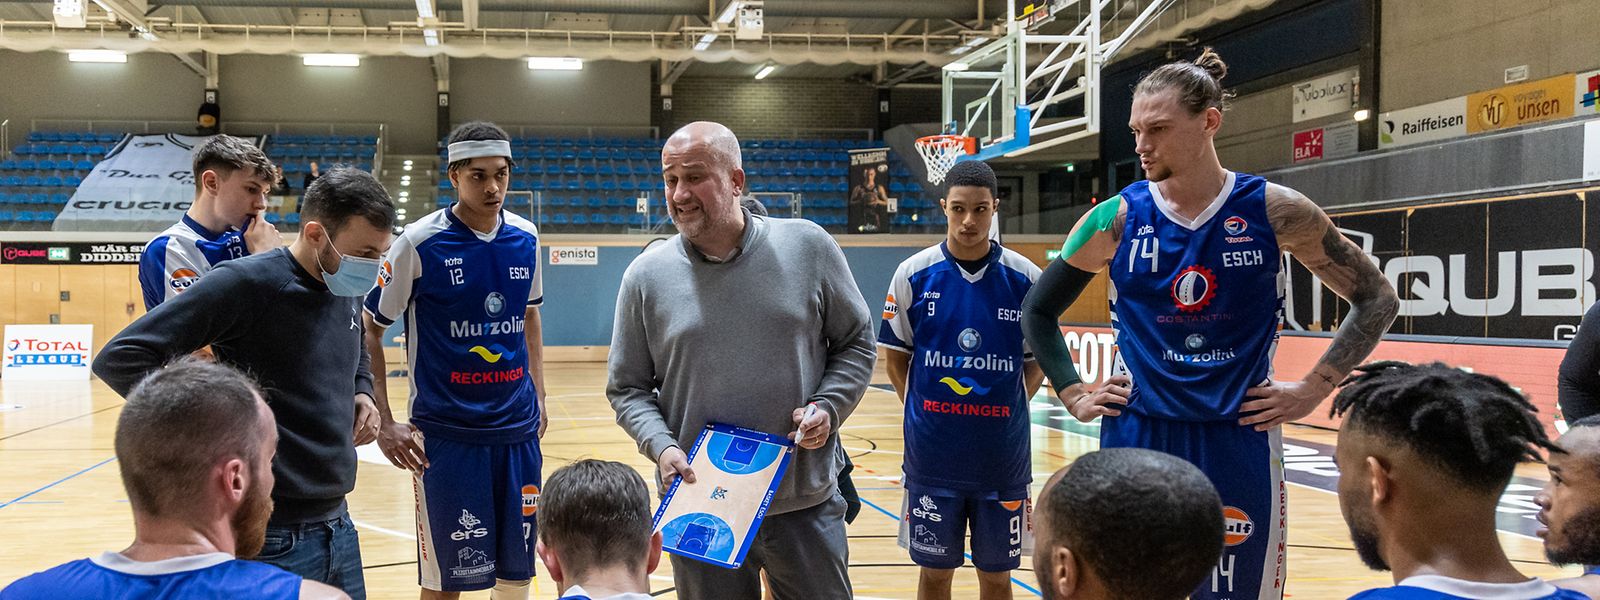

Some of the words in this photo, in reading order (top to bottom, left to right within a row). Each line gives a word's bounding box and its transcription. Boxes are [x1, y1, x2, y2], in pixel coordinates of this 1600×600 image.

[1402, 114, 1464, 136] Raiffeisen
[91, 244, 128, 253] MÄR
[551, 248, 596, 263] genista
[1128, 236, 1160, 273] 14
[1222, 250, 1264, 268] ESCH
[449, 268, 465, 286] 12
[509, 267, 530, 280] ESCH
[927, 302, 936, 317] 9
[998, 308, 1023, 322] ESCH
[24, 338, 88, 351] TOTAL
[16, 355, 79, 364] LEAGUE
[924, 350, 1014, 372] Muzzolini
[450, 366, 524, 385] RECKINGER
[923, 399, 1011, 418] RECKINGER
[1009, 515, 1021, 546] 9
[1211, 553, 1236, 593] 14
